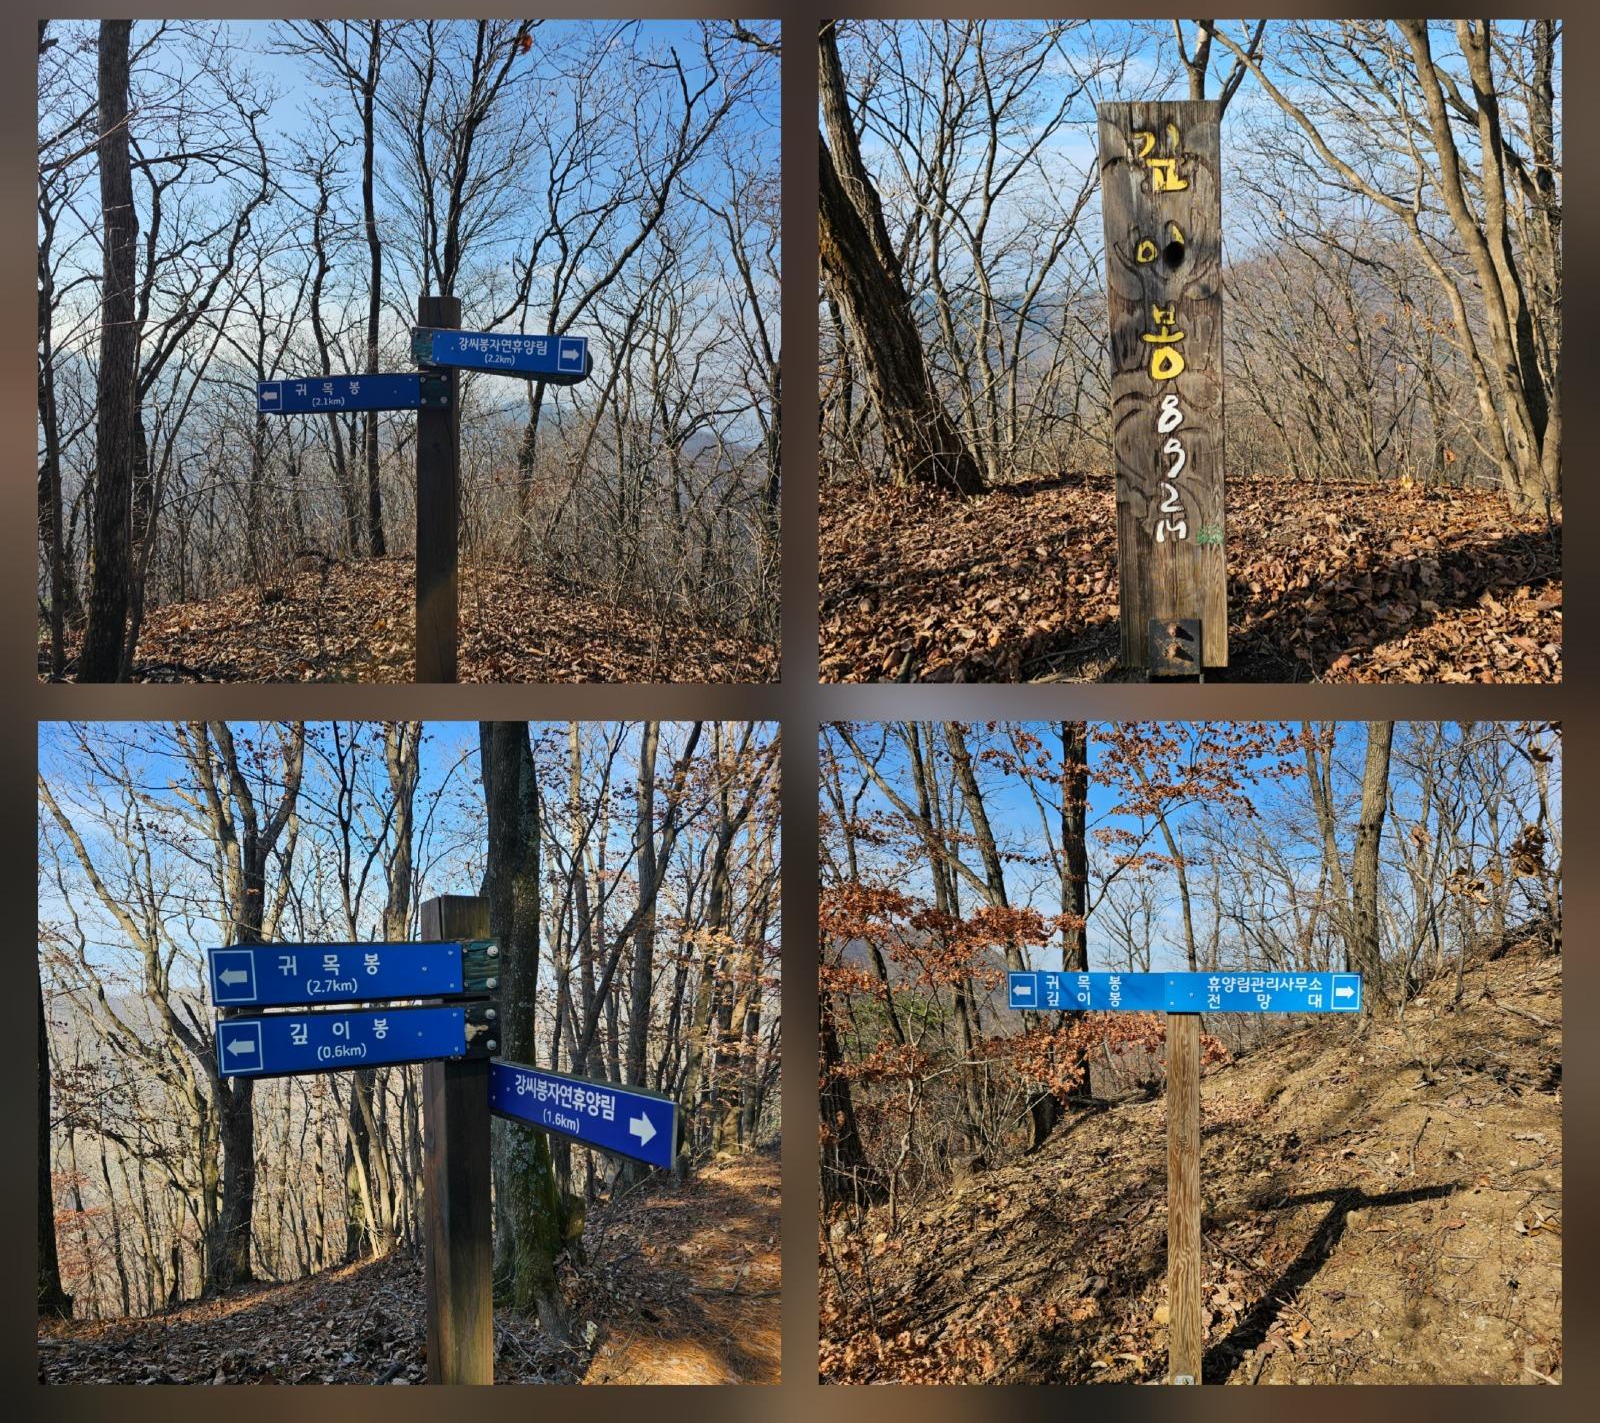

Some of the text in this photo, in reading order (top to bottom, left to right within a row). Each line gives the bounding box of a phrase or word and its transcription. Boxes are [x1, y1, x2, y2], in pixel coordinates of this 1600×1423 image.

[458, 337, 548, 356] 강씨봉자연휴양림
[484, 353, 516, 366] (2.2km)
[311, 396, 345, 408] (2.1km)
[306, 978, 358, 996] (2.7km)
[1207, 976, 1323, 993] 휴양림관리사무소
[317, 1042, 367, 1062] (0.6km)
[514, 1074, 616, 1122] 강씨봉자연휴양림
[542, 1108, 580, 1135] (1.6km)
